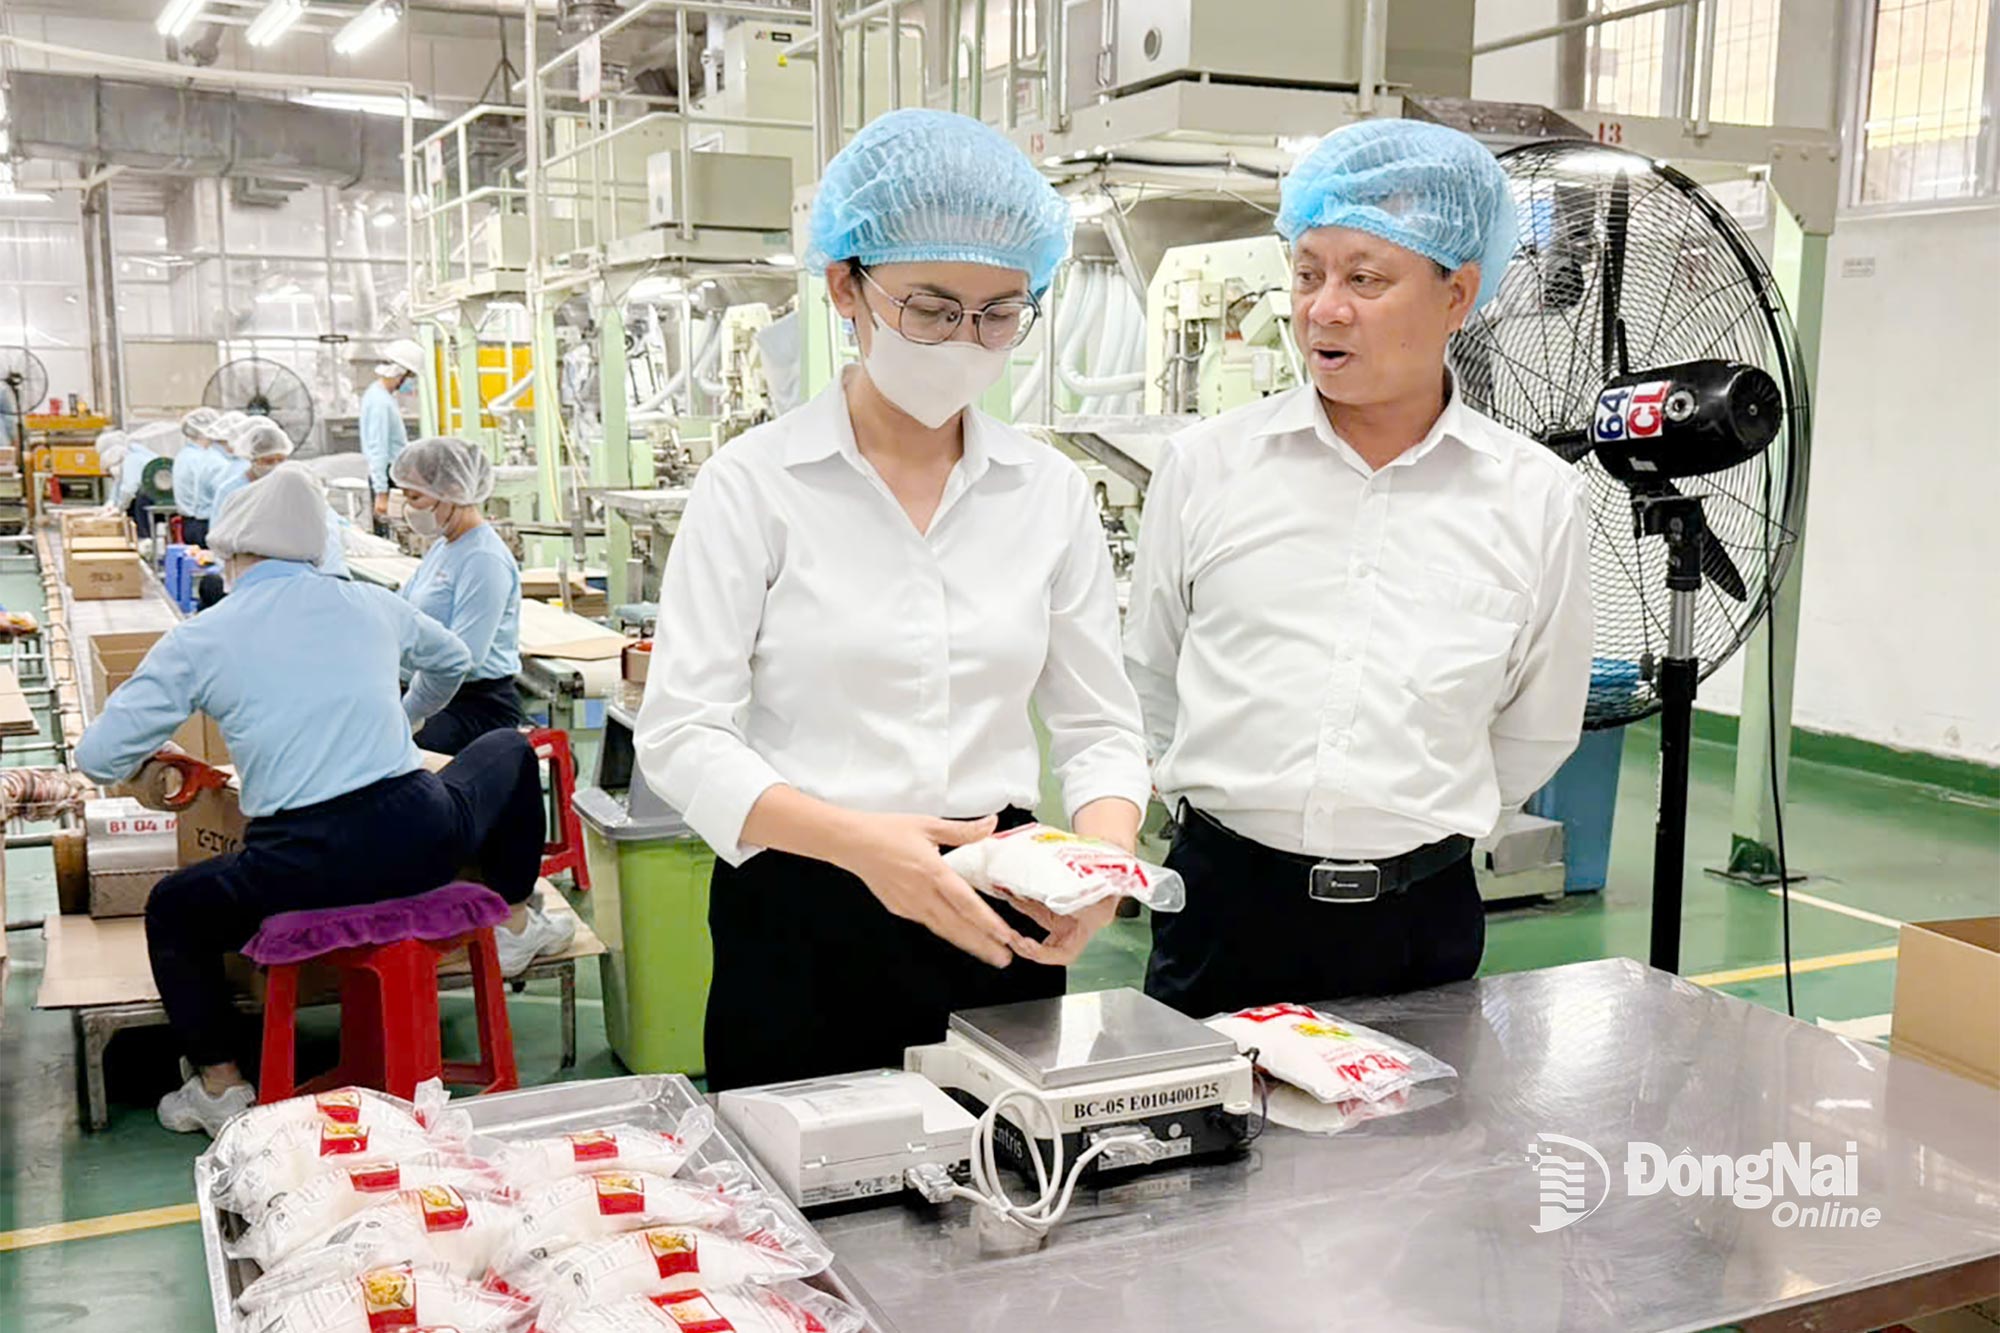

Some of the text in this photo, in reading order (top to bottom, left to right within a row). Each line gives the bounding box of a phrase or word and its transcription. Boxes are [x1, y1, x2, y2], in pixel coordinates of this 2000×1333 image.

[1597, 390, 1629, 439] 64
[1629, 384, 1666, 436] CL
[1074, 1082, 1219, 1119] BC-05 E010400125
